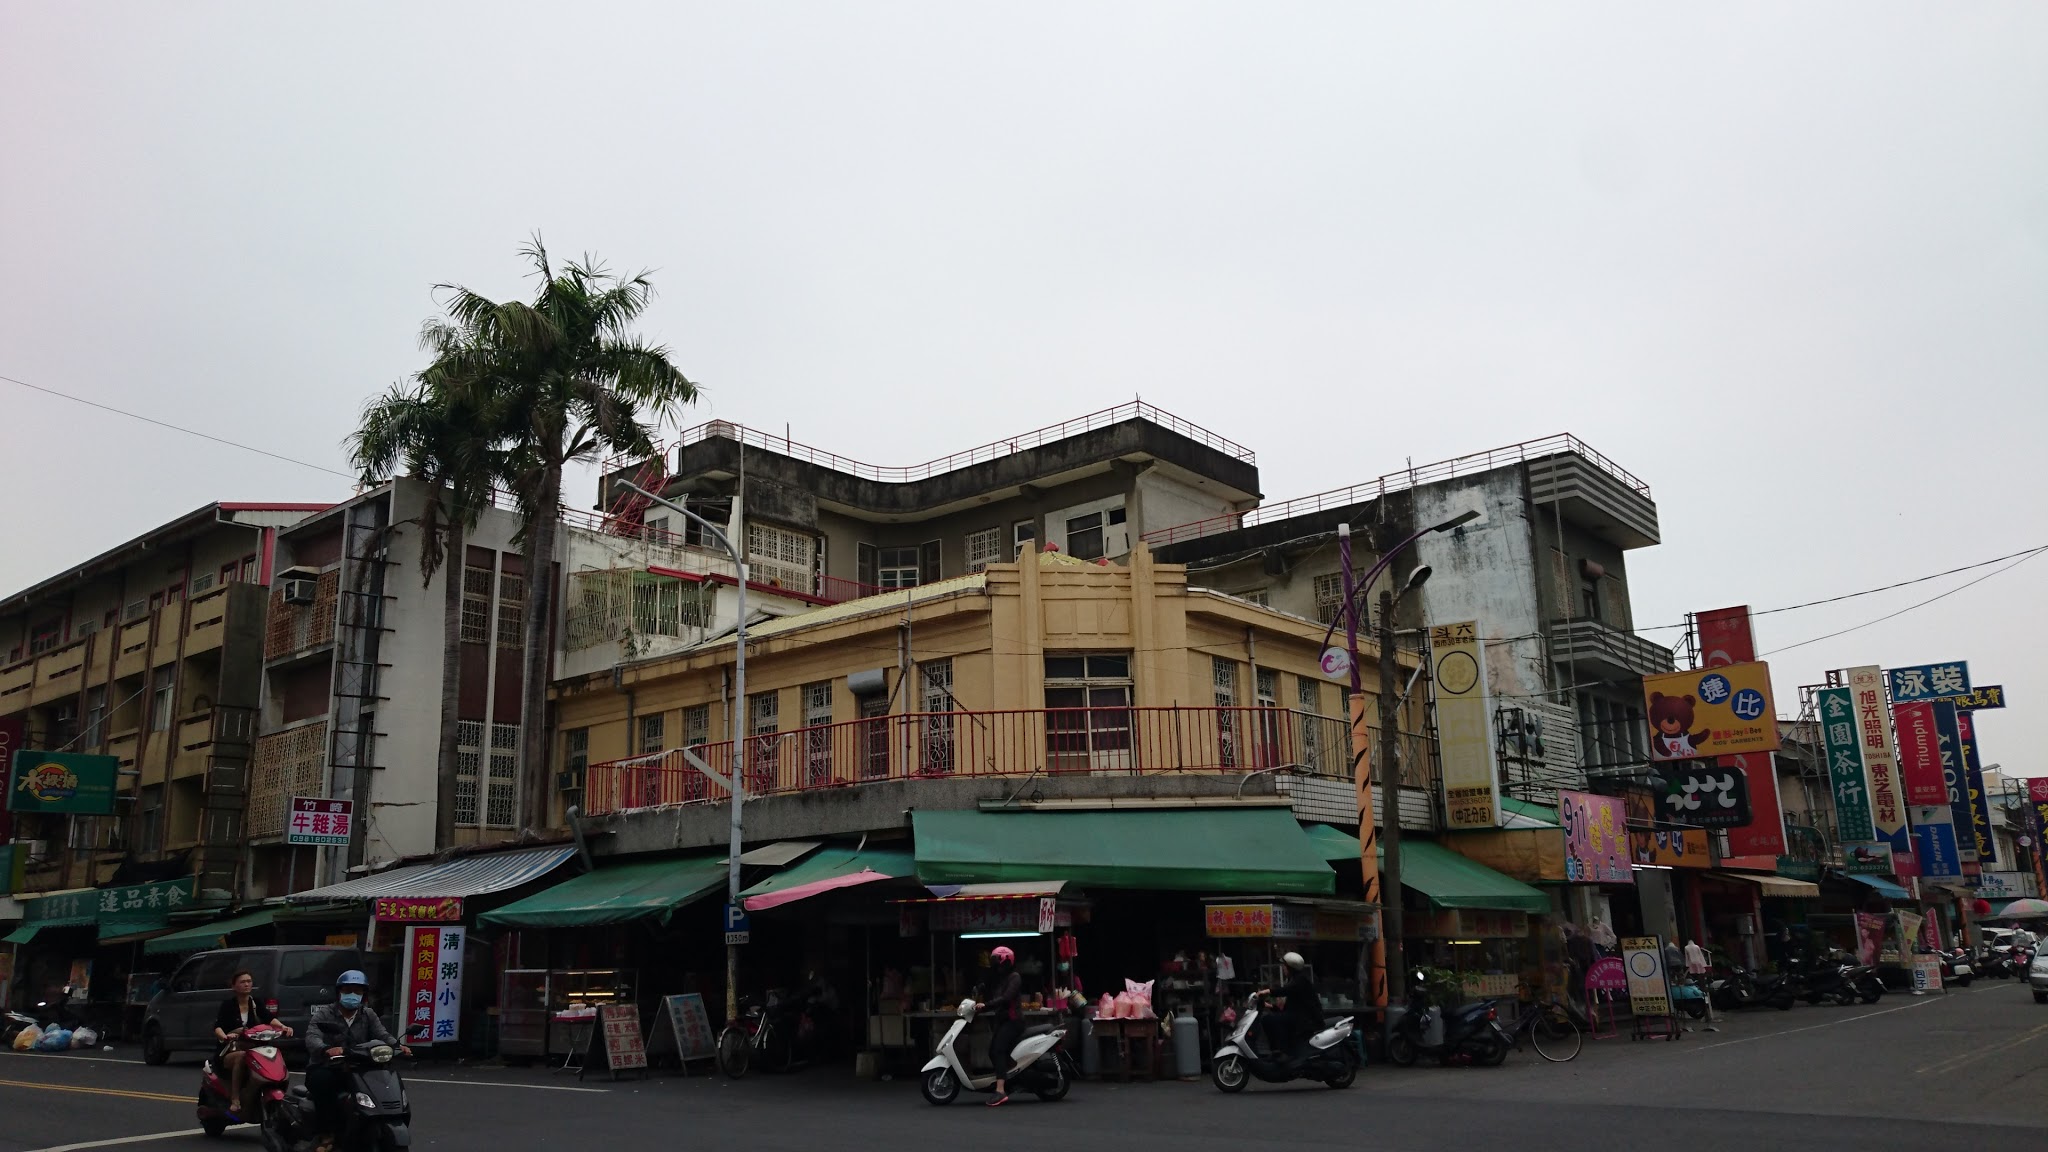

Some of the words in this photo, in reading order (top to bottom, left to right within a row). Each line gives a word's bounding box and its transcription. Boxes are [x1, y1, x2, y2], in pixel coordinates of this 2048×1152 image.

[1435, 624, 1473, 639] 斗六
[1701, 677, 1761, 717] 捷比
[1895, 665, 1966, 698] 泳裝
[1859, 689, 1885, 749] 旭光照明
[1823, 693, 1863, 806] 金園茶行
[1864, 751, 1892, 760] TOSHIBA
[1912, 719, 1931, 770] Triumph
[1938, 733, 1960, 803] SONY
[1871, 764, 1896, 823] 東芝電材
[292, 812, 349, 835] 牛雜湯
[1452, 806, 1491, 824] (中正分店)
[1563, 797, 1586, 847] 911
[99, 885, 188, 913] 蓮品素食
[729, 906, 745, 928] P
[1915, 969, 1927, 989] 包子
